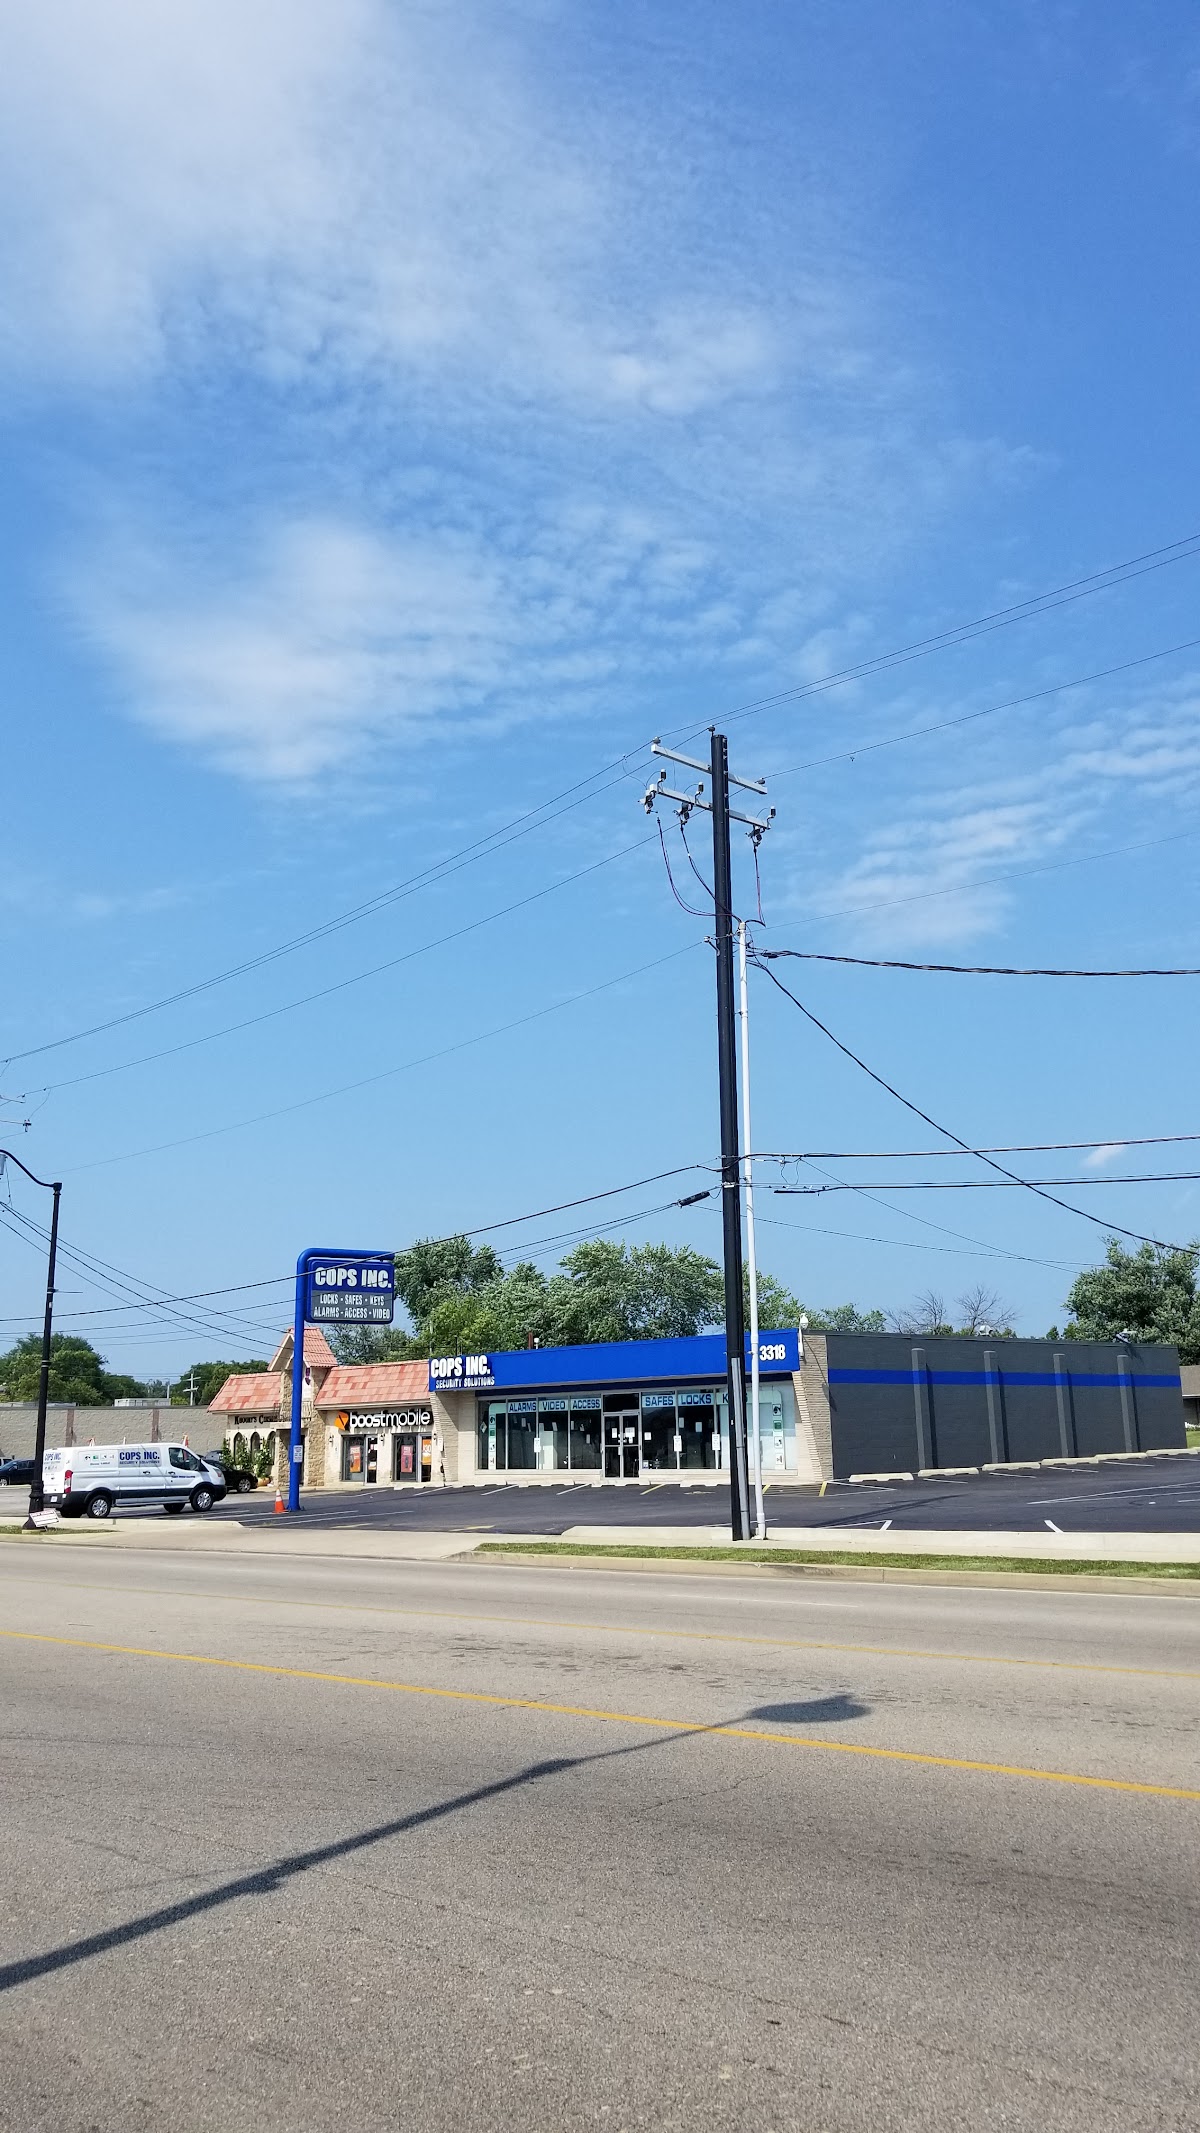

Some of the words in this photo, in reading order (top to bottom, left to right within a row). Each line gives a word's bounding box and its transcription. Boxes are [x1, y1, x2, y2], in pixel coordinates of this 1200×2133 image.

[315, 1267, 357, 1286] COPS
[362, 1269, 392, 1288] INC.
[320, 1294, 338, 1304] LOCKS
[345, 1295, 362, 1304] SAFES
[370, 1296, 384, 1306] KEYS
[314, 1307, 340, 1318] ALARMS
[344, 1308, 368, 1318] ACCESS
[372, 1308, 390, 1318] VIDEO
[759, 1344, 786, 1360] 3318
[430, 1357, 462, 1378] COPS
[466, 1355, 490, 1375] INC.
[436, 1379, 462, 1388] SECURITY
[464, 1376, 494, 1387] SOLUTIONS
[508, 1402, 536, 1412] ALARMS
[542, 1401, 566, 1410] VIDEO
[572, 1400, 600, 1409] ACCESS
[645, 1396, 674, 1406] SAFES
[681, 1394, 712, 1404] LOCKS
[120, 1452, 141, 1460] COPS
[144, 1452, 160, 1460] INC.
